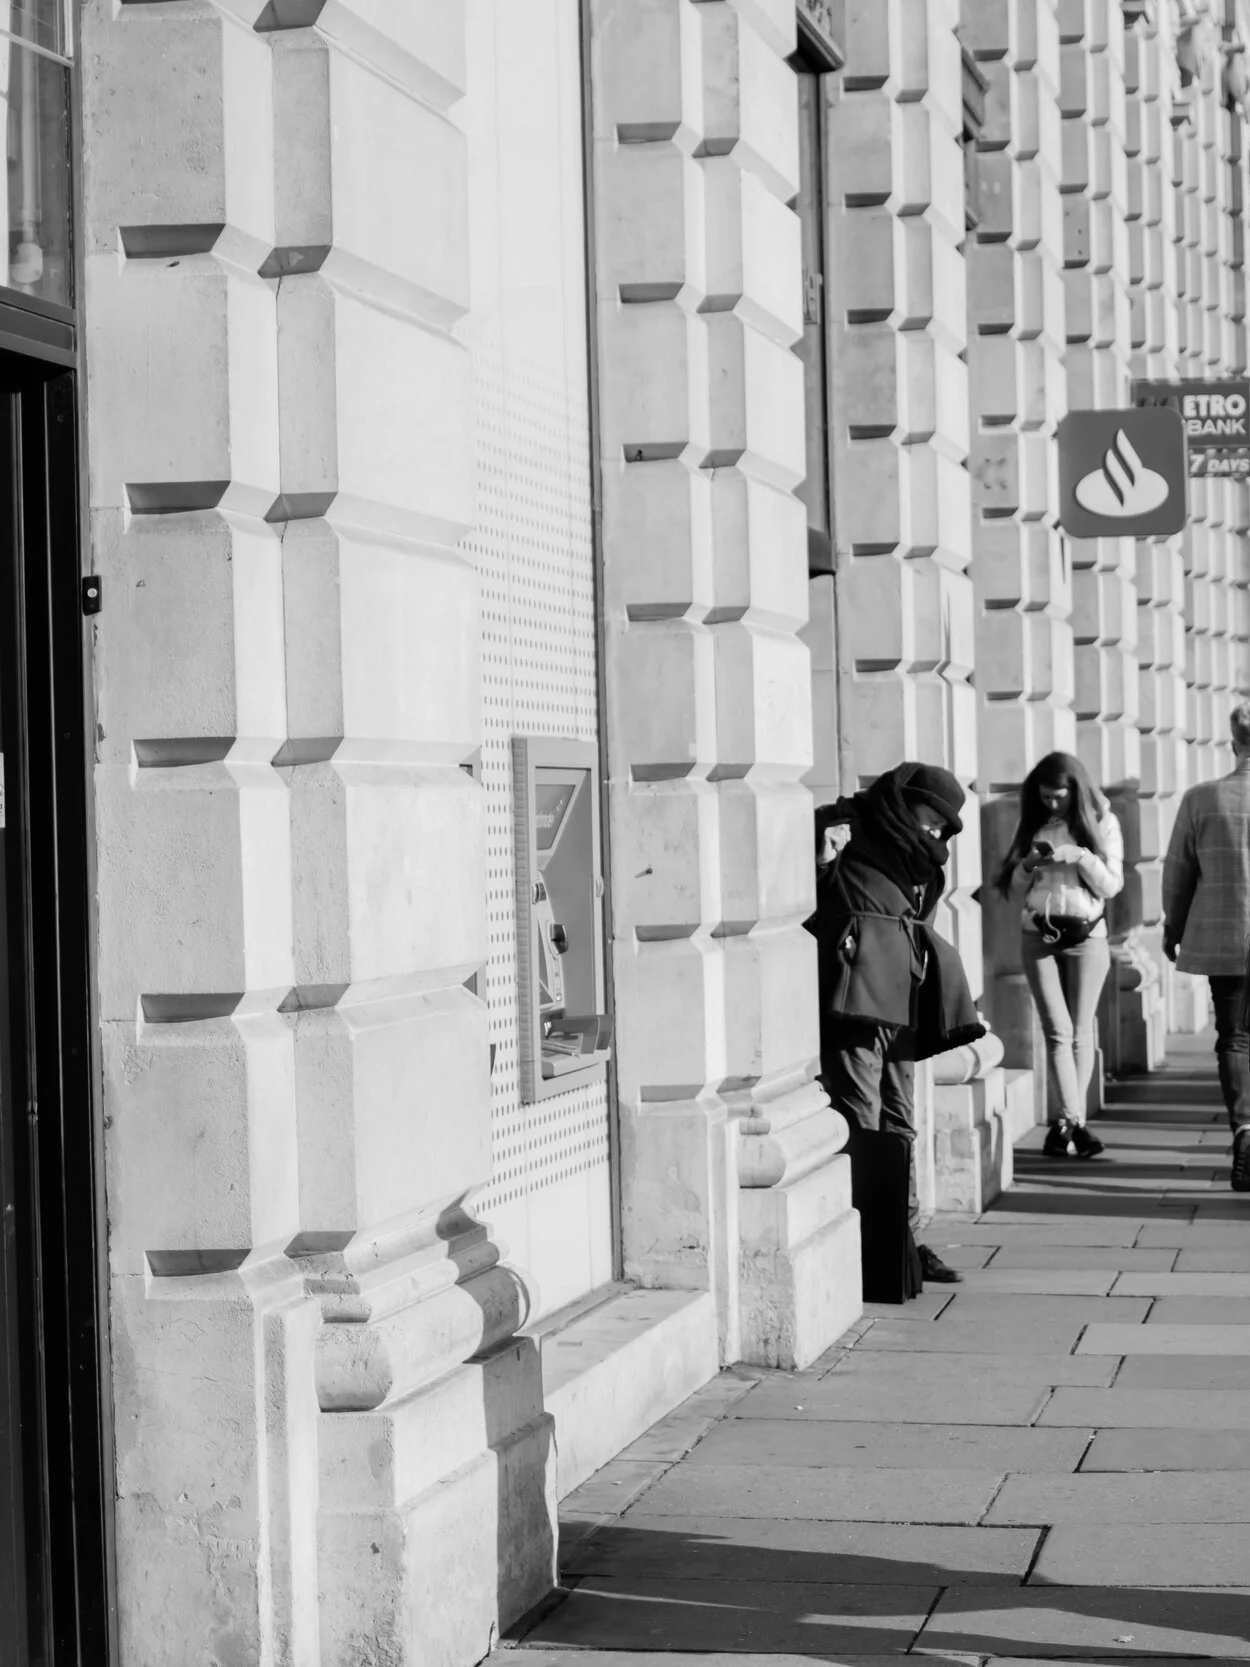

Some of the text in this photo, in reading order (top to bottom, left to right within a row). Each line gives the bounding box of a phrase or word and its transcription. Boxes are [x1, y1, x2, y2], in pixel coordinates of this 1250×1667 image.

[1140, 394, 1247, 418] ETRO
[1187, 419, 1246, 435] BANK
[1189, 454, 1250, 473] 7 DAYS
